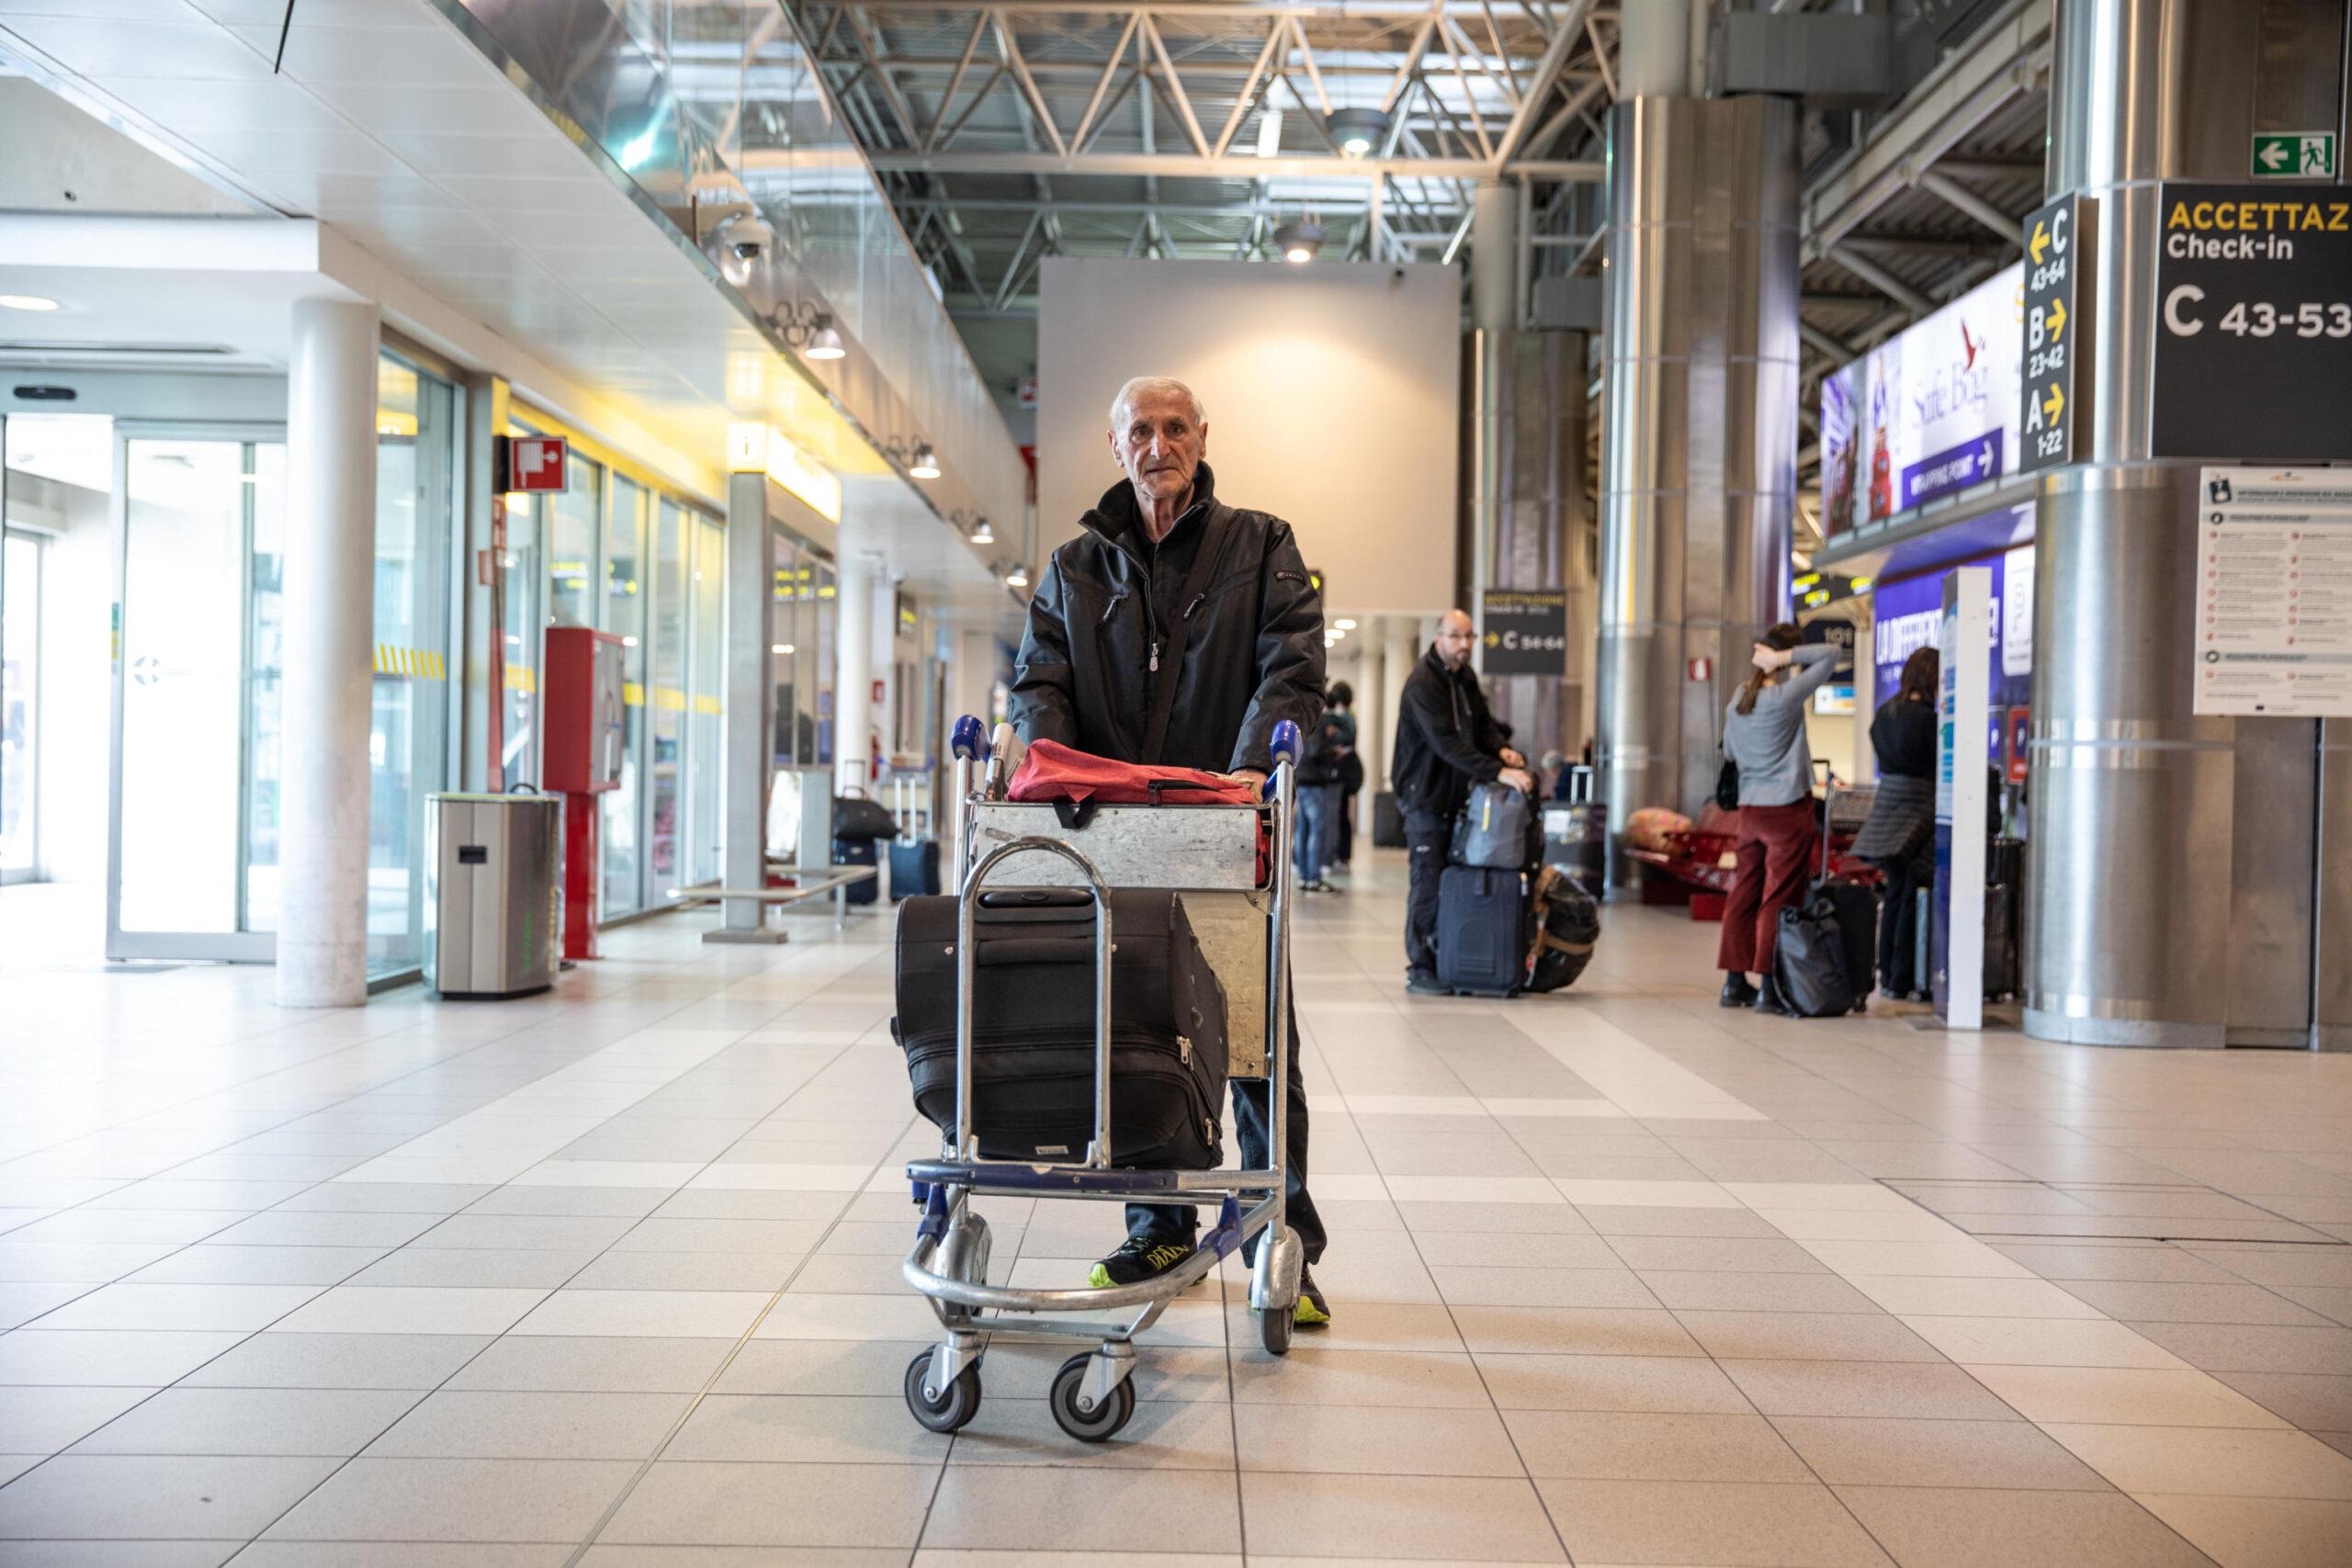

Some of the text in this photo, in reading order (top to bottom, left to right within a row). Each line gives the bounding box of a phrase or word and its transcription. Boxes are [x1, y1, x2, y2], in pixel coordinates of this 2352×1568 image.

[2051, 207, 2068, 254] C
[2167, 202, 2349, 231] ACCETTAZ
[2166, 233, 2293, 260] Check-in
[2030, 261, 2066, 293] 43-64
[2164, 284, 2352, 338] C 43-53
[2029, 306, 2045, 351] B
[2029, 344, 2064, 379] 23-42
[2026, 389, 2045, 434] A
[2037, 429, 2063, 458] 1-22
[1502, 630, 1519, 650] C
